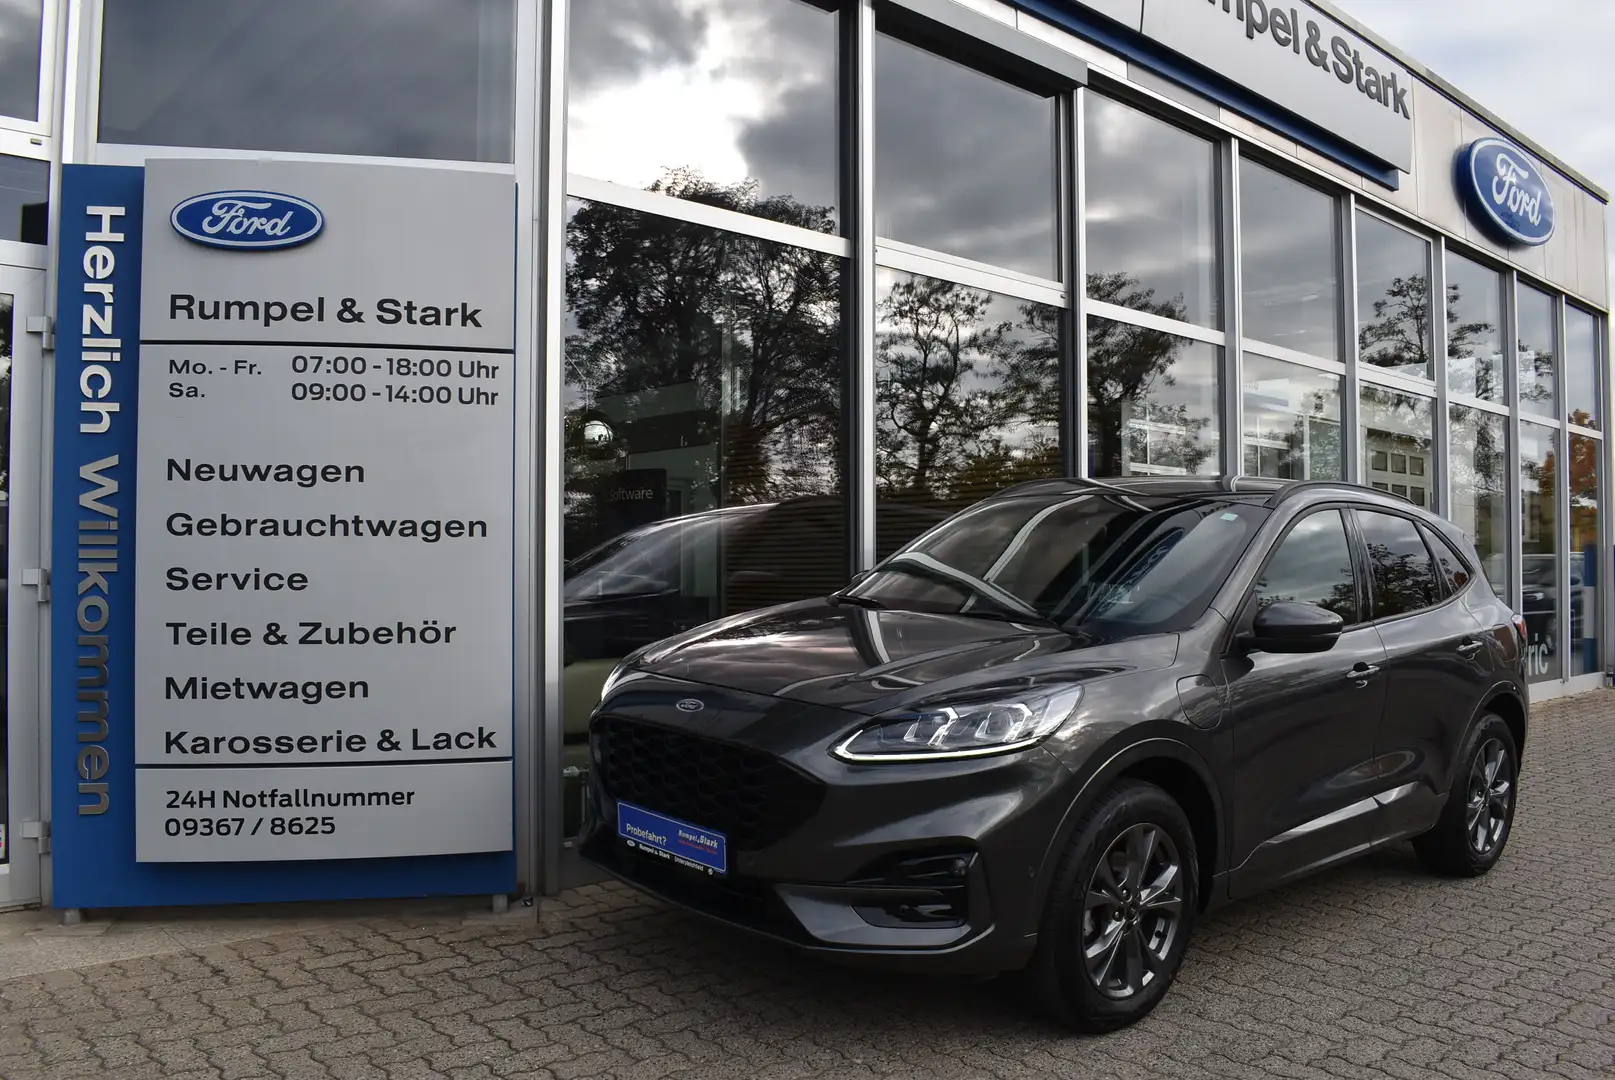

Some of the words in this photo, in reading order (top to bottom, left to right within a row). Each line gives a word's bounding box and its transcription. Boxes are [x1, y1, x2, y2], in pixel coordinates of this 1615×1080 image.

[1304, 20, 1331, 73] &
[1331, 35, 1410, 120] Stark
[1492, 153, 1542, 227] Ford
[202, 199, 294, 236] Ford
[79, 206, 126, 434] Herzlich
[169, 294, 325, 327] Rumpel
[336, 298, 366, 324] &
[376, 299, 483, 328] Stark
[169, 359, 213, 375] Mo.
[234, 359, 262, 376] Fr.
[291, 356, 367, 375] 07:00
[387, 358, 452, 378] 18:00
[458, 361, 500, 380] Uhr
[168, 382, 206, 398] Sa.
[291, 382, 367, 402] 09:00
[387, 385, 452, 404] 14:00
[458, 387, 499, 406] Uhr
[167, 458, 366, 488] Neuwagen
[166, 512, 488, 543] Gebrauchtwagen
[166, 567, 309, 591] Service
[77, 454, 120, 815] Willkommen
[166, 622, 252, 646] Teile
[262, 622, 289, 646] &
[298, 620, 457, 645] Zubehör
[1528, 632, 1548, 676] ric
[165, 676, 369, 705] Mietwagen
[165, 730, 367, 755] Karosserie
[376, 728, 402, 752] &
[412, 726, 498, 751] Lack
[165, 790, 216, 809] 24H
[222, 788, 415, 809] Notfallnummer
[164, 817, 245, 837] 09367
[270, 816, 336, 836] 8625
[626, 823, 667, 846] Probefahrt?
